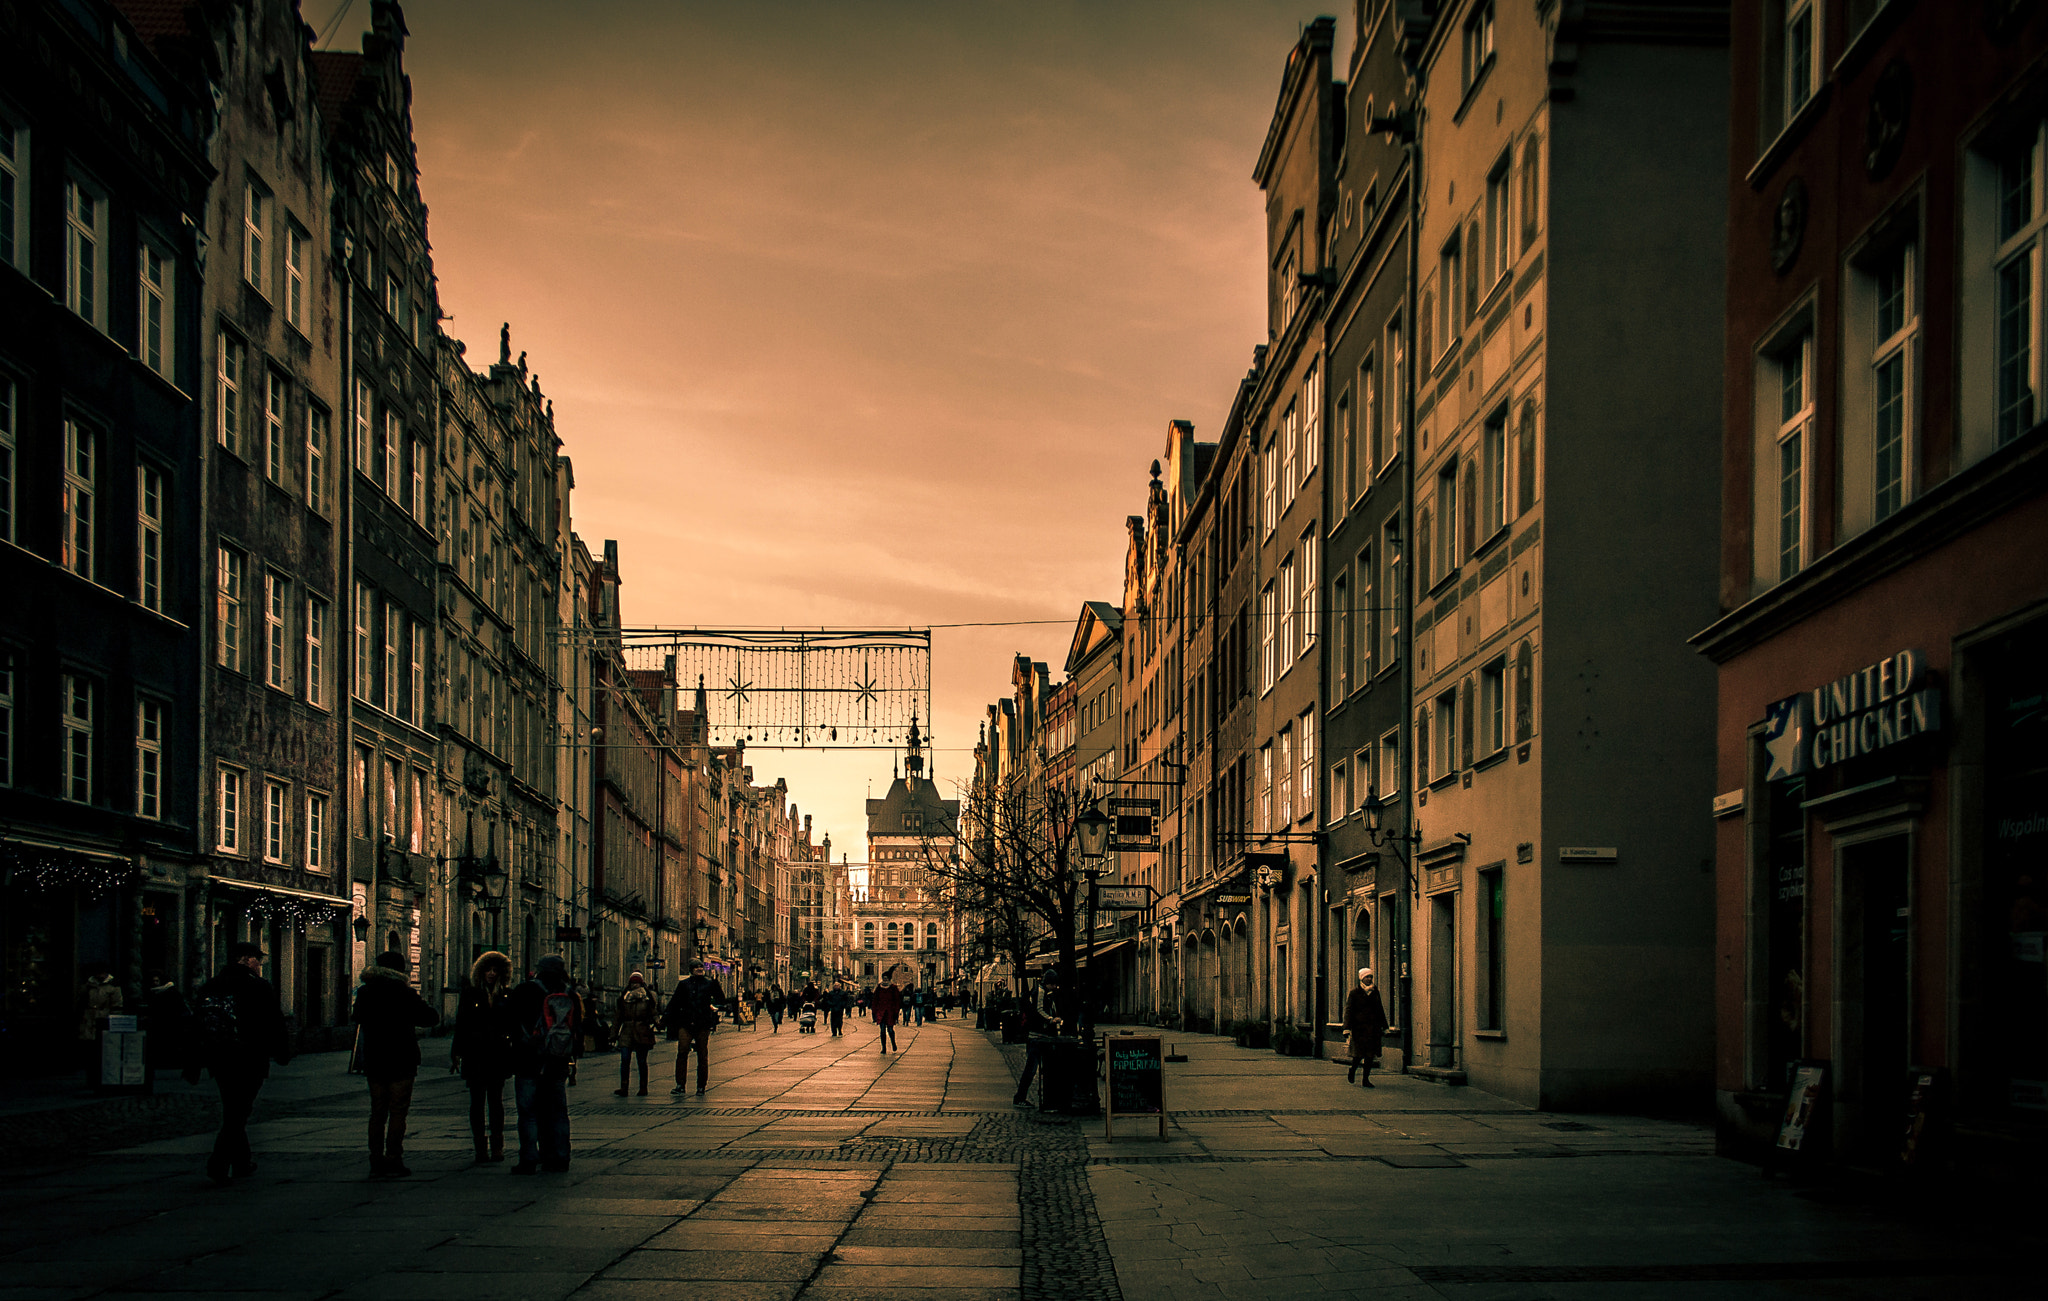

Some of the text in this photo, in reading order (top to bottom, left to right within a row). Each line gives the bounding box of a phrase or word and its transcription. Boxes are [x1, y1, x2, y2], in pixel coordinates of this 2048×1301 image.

[1813, 649, 1914, 727] UNITED
[1812, 689, 1926, 770] CHICKEN
[1216, 895, 1251, 903] SUBWAY
